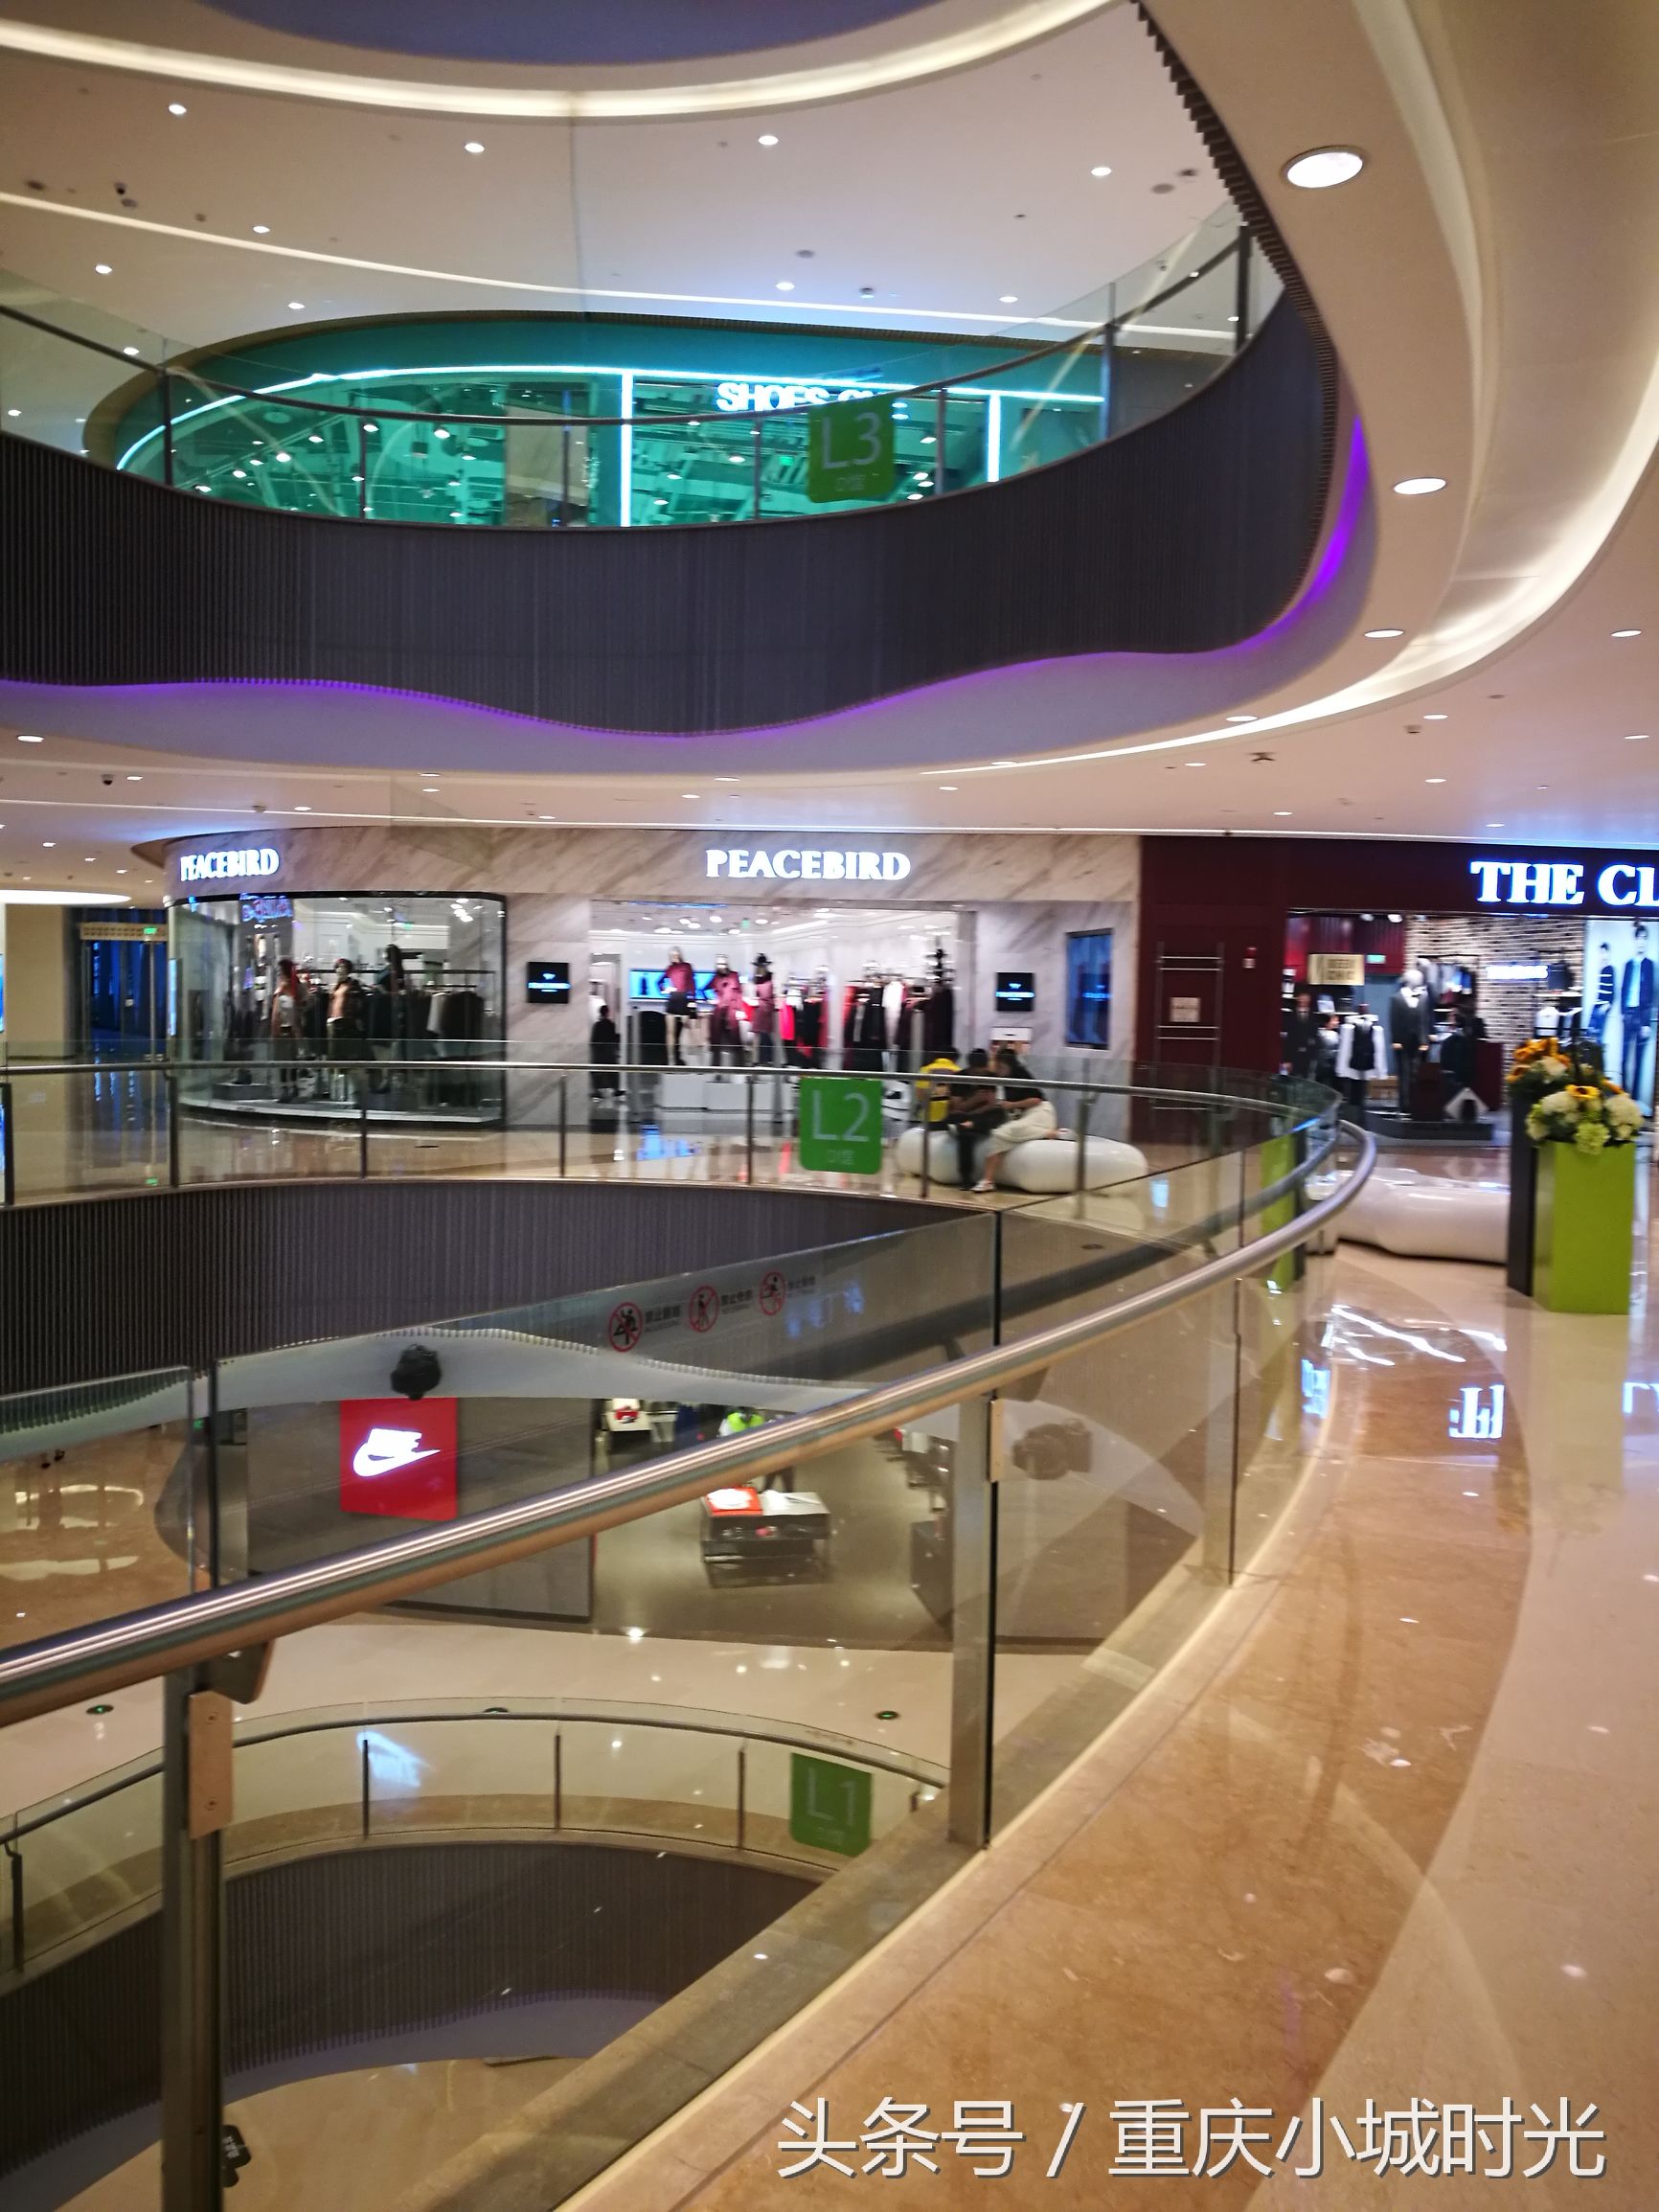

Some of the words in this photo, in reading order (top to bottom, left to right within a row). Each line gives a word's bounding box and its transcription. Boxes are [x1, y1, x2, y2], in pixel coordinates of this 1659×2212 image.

[716, 382, 830, 411] SHOES
[821, 412, 881, 469] L3
[180, 848, 280, 881] PEACEBIRD
[706, 849, 911, 880] PEACEBIRD
[1470, 861, 1585, 904] THE
[811, 1090, 870, 1142] L2
[807, 1767, 857, 1827] L1
